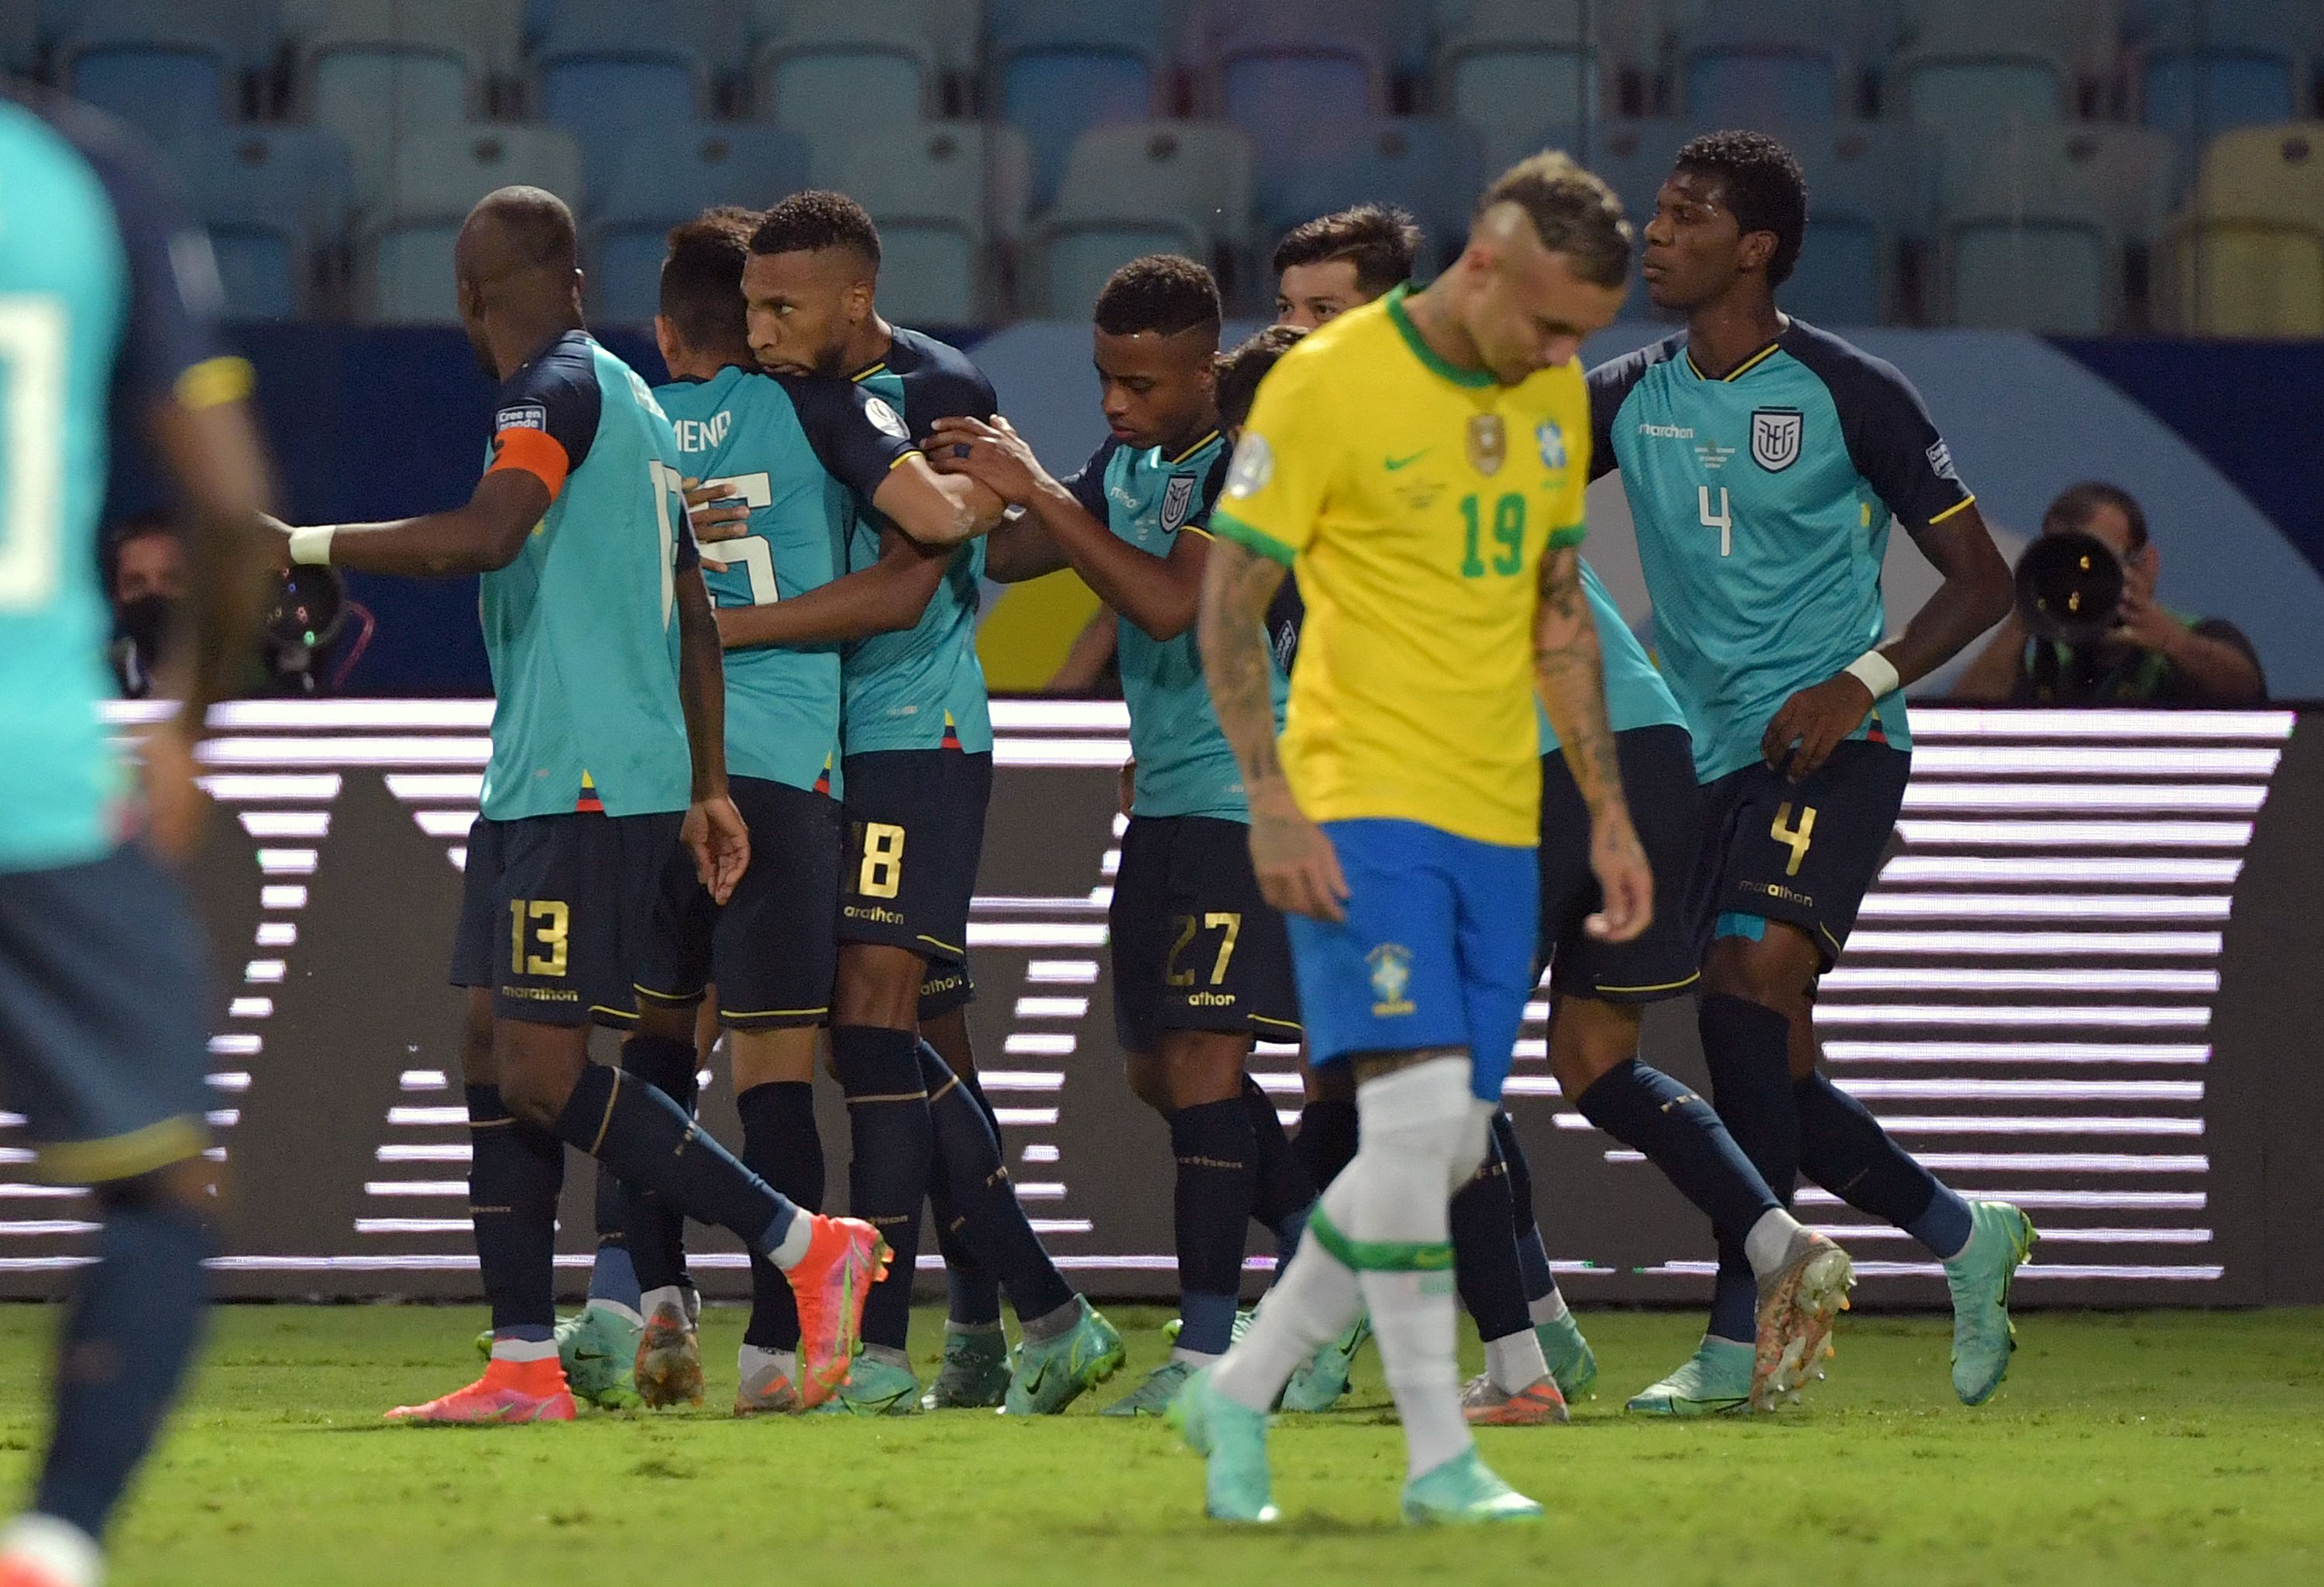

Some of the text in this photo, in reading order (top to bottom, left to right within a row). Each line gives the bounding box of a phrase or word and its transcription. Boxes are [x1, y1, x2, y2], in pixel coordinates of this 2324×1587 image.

[499, 411, 524, 423] Cree
[1459, 493, 1526, 578] 19
[1698, 485, 1731, 556] 4
[1770, 801, 1817, 877] 4
[510, 899, 569, 977] 13
[844, 905, 904, 926] arathon
[1165, 912, 1241, 985] 27
[502, 984, 579, 1002] marathon
